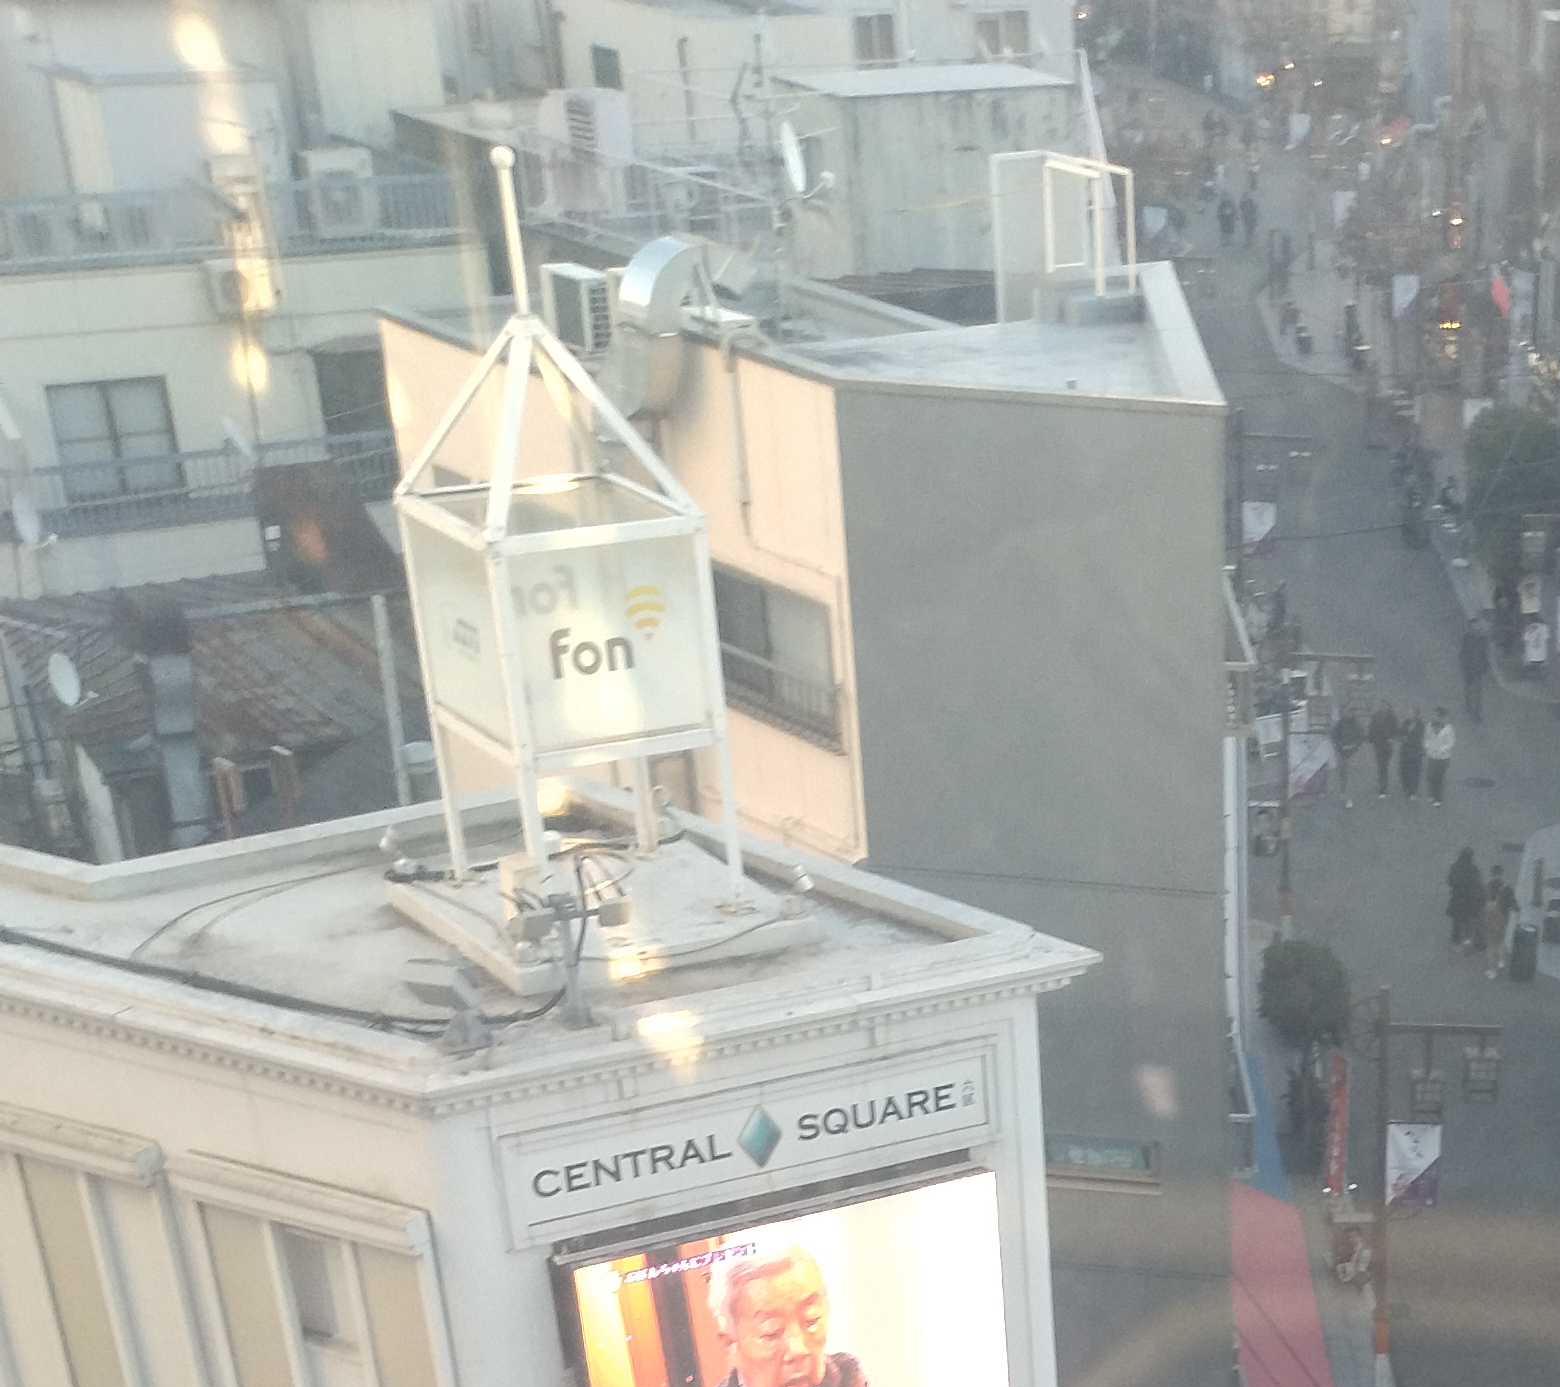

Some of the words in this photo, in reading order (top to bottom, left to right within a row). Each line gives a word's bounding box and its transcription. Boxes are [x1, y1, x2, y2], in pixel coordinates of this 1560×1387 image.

[548, 627, 635, 680] fon
[532, 1133, 733, 1199] CENTRAL
[797, 1082, 959, 1142] SQUARE
